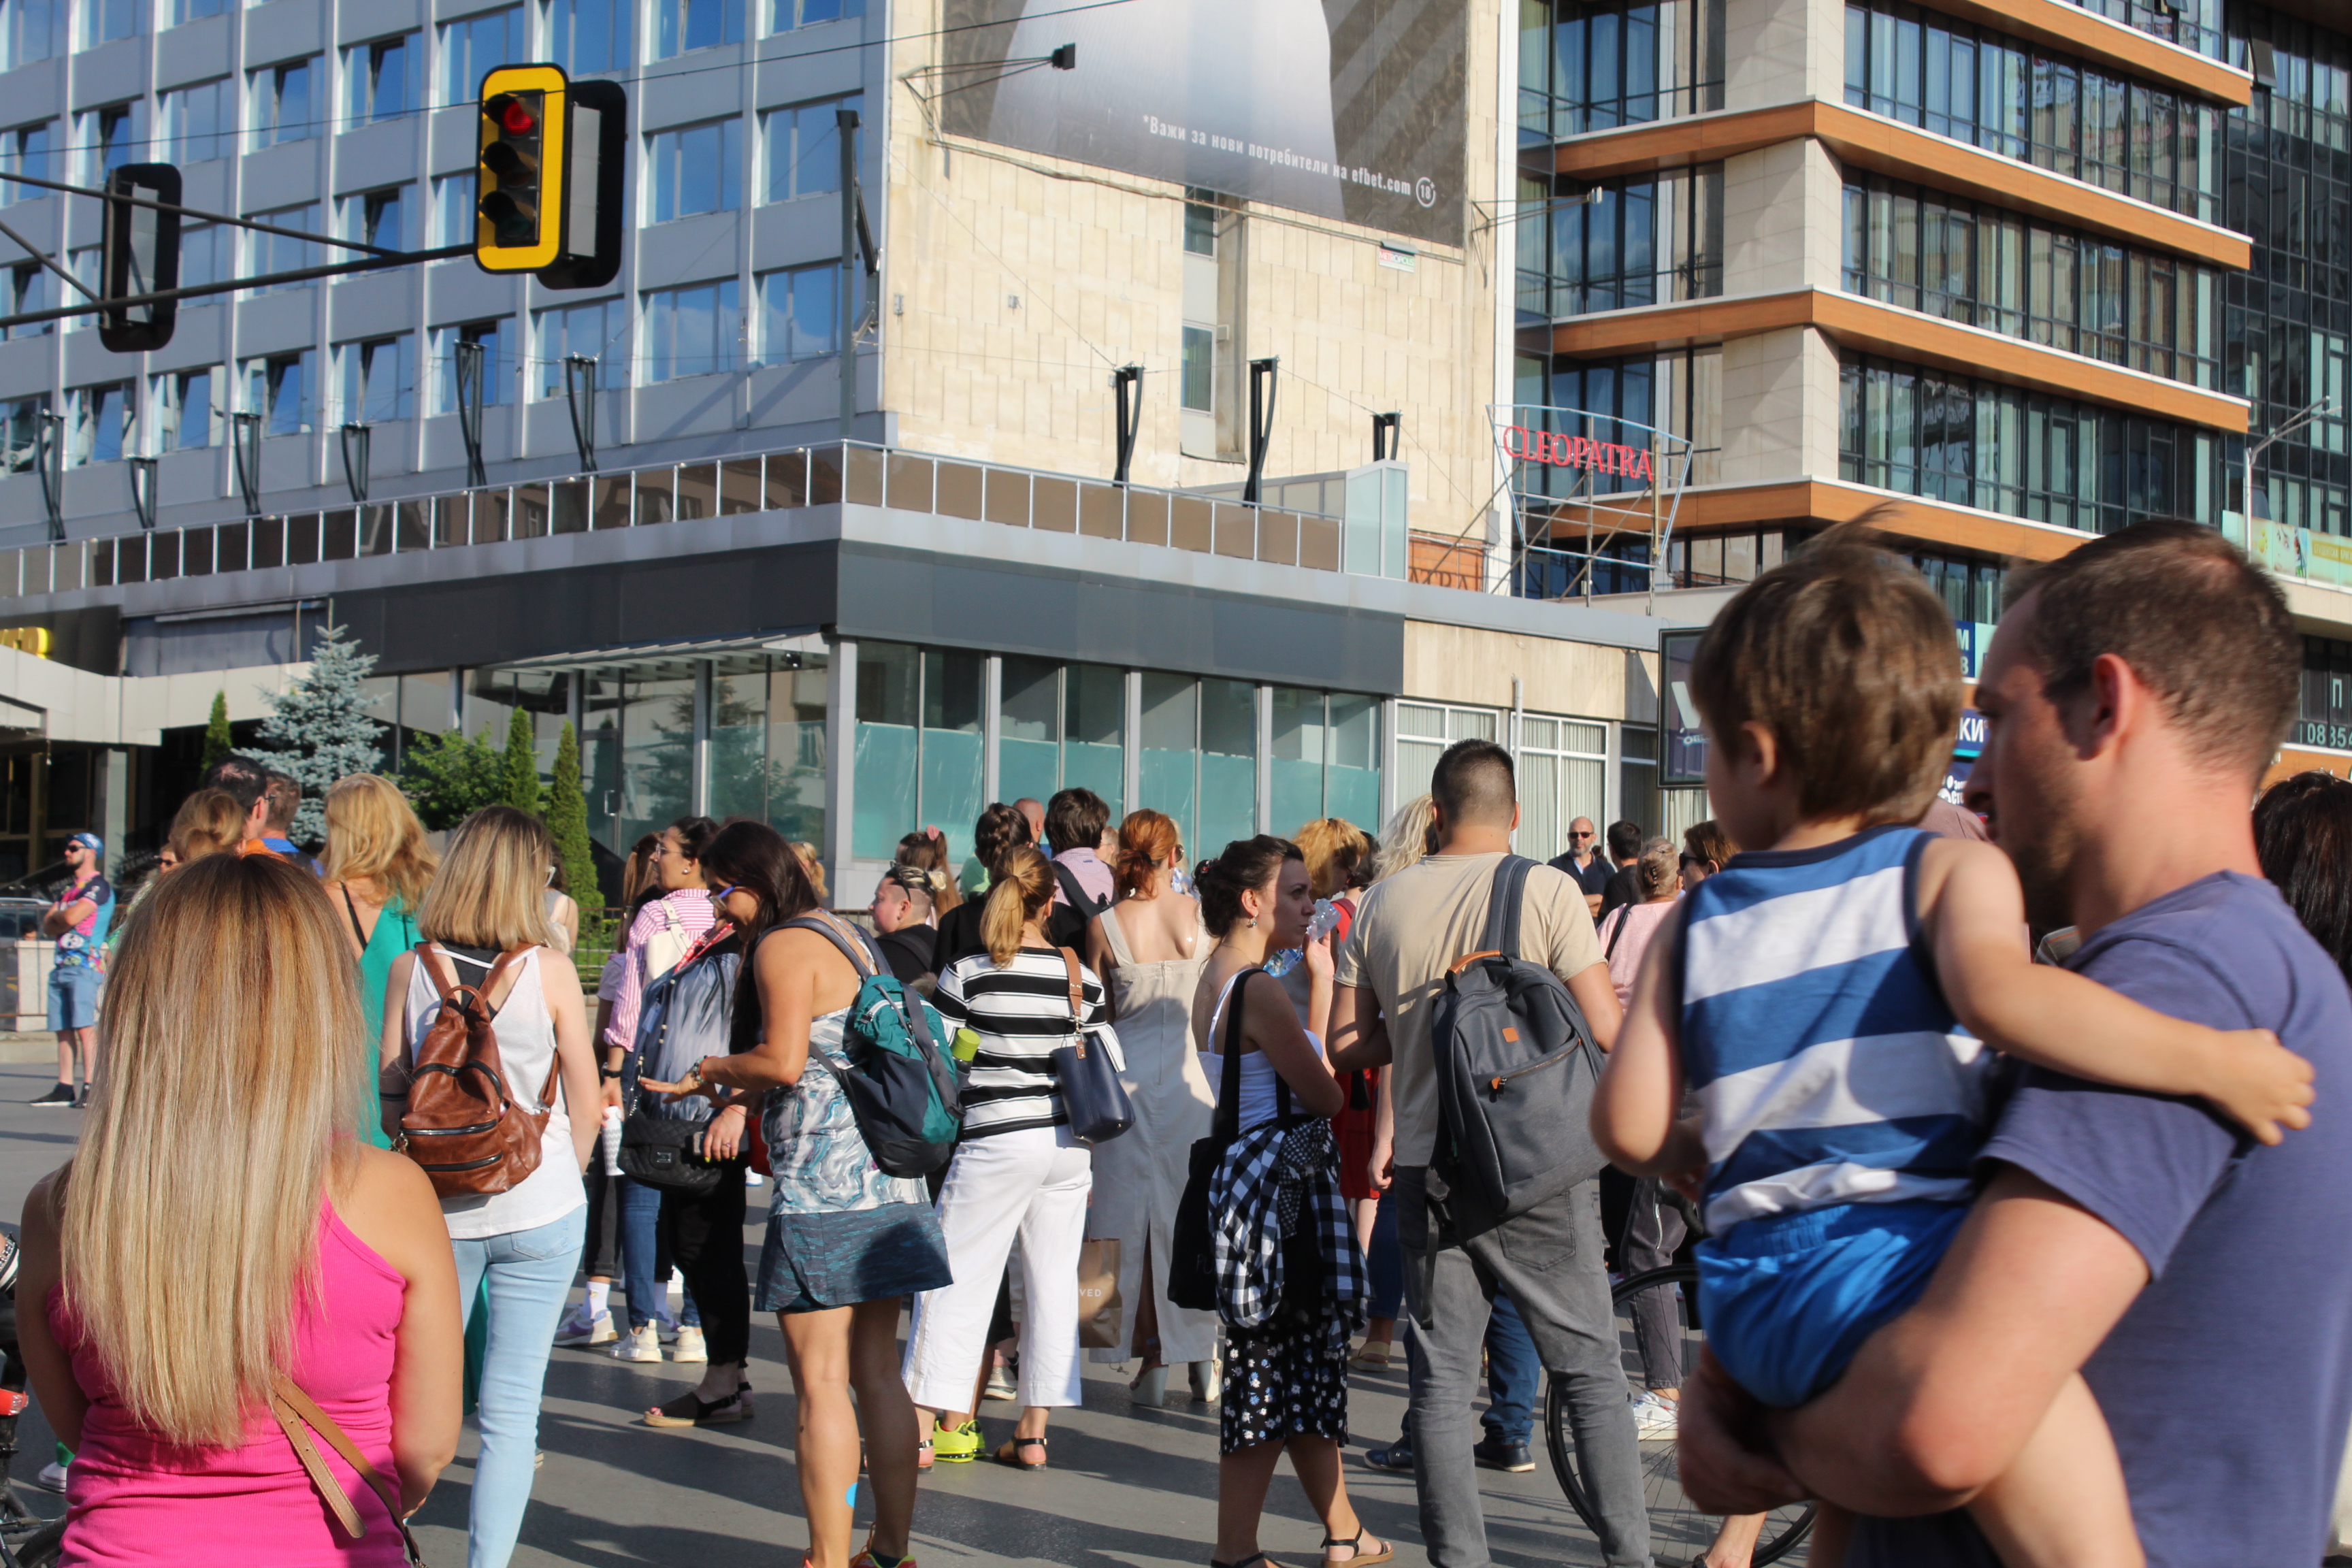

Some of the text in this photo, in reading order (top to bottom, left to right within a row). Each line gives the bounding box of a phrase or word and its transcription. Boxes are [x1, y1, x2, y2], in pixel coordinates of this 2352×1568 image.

[1191, 129, 1206, 146] за
[1211, 134, 1244, 154] нови
[1248, 143, 1328, 176] потребители
[1333, 163, 1348, 180] на
[1352, 167, 1411, 196] efbet.com
[1379, 249, 1415, 267] METROPOLIS
[1503, 425, 1654, 483] CLEOPATRA
[1956, 717, 1984, 743] КИ
